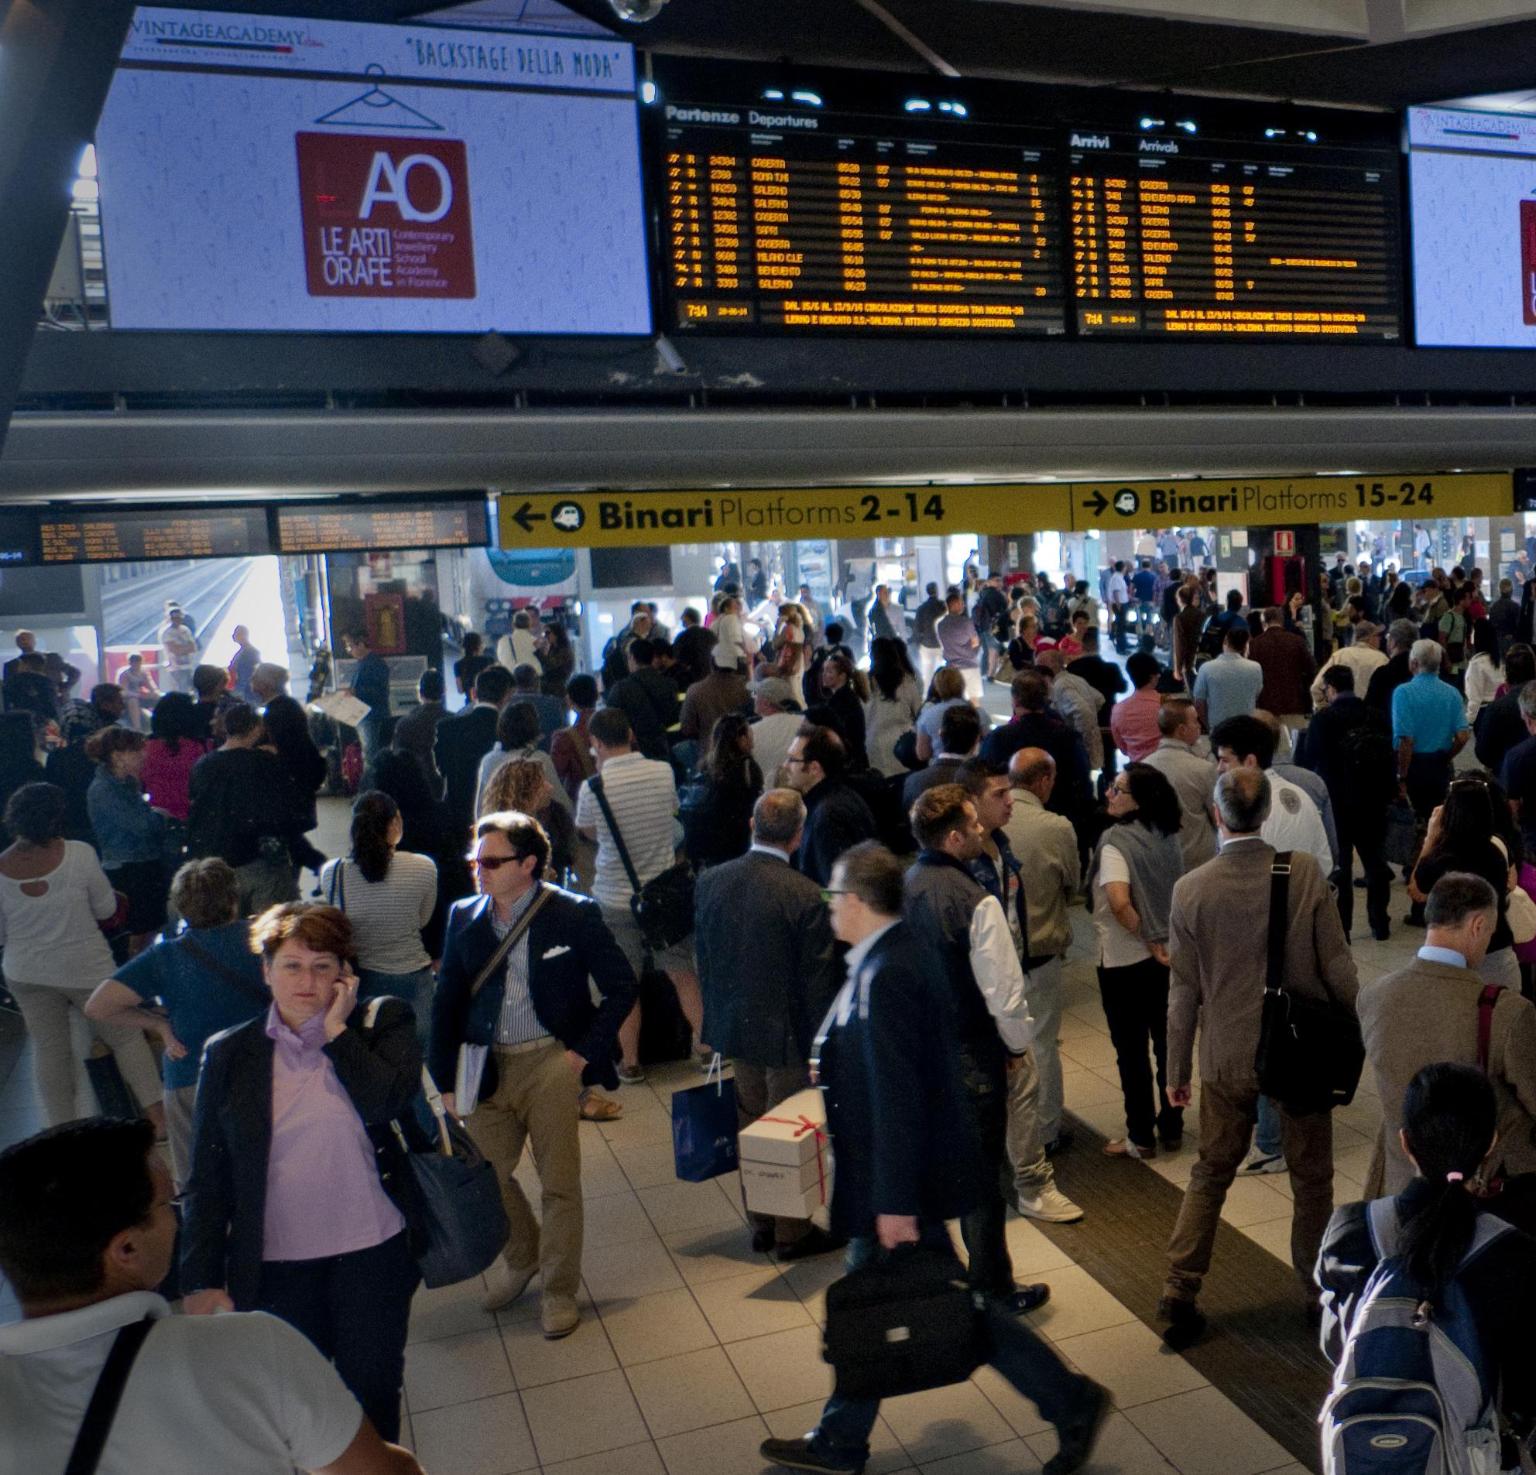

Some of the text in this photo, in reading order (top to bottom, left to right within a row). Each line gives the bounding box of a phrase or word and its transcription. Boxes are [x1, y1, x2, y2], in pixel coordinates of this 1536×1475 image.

[518, 48, 564, 75] DELLA
[666, 105, 819, 129] Partenze Departures
[1071, 134, 1179, 154] Arrivi Arrivals
[321, 227, 392, 257] LE ARTI
[393, 229, 455, 243] Contemporary
[324, 256, 393, 287] ORAFE
[395, 254, 427, 264] School
[396, 265, 438, 278] Academy
[1150, 483, 1434, 514] Binari Platforms 15-24
[599, 500, 714, 530] Binari
[720, 498, 856, 527] Platforms
